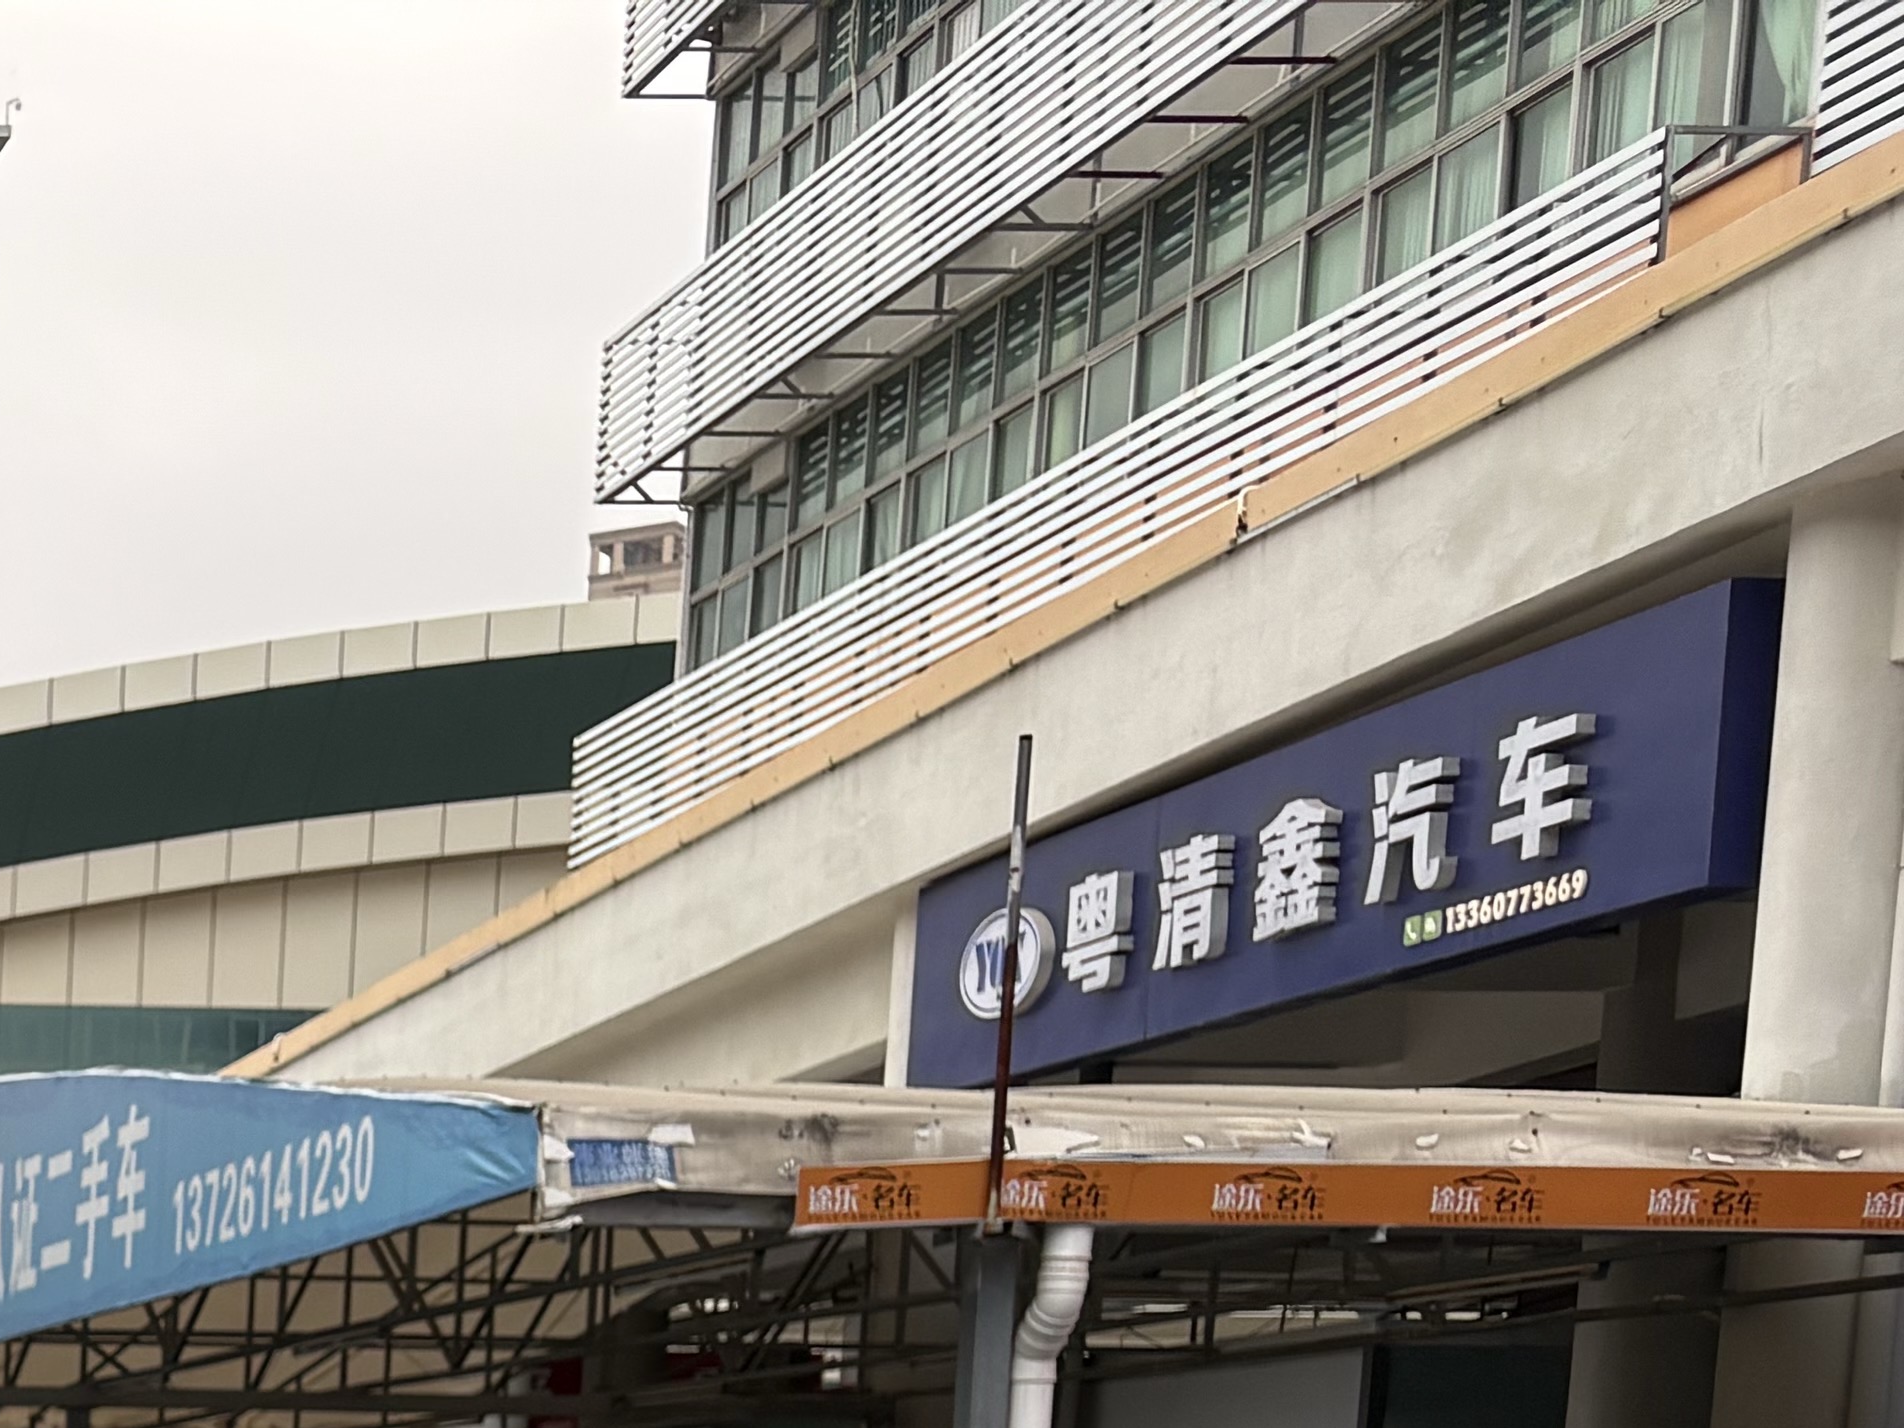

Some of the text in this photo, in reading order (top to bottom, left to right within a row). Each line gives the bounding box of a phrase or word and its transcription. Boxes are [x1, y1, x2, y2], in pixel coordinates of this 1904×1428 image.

[1062, 712, 1595, 993] 粤清鑫汽车
[1445, 868, 1589, 935] 13360773669
[173, 1115, 375, 1255] 13726141230
